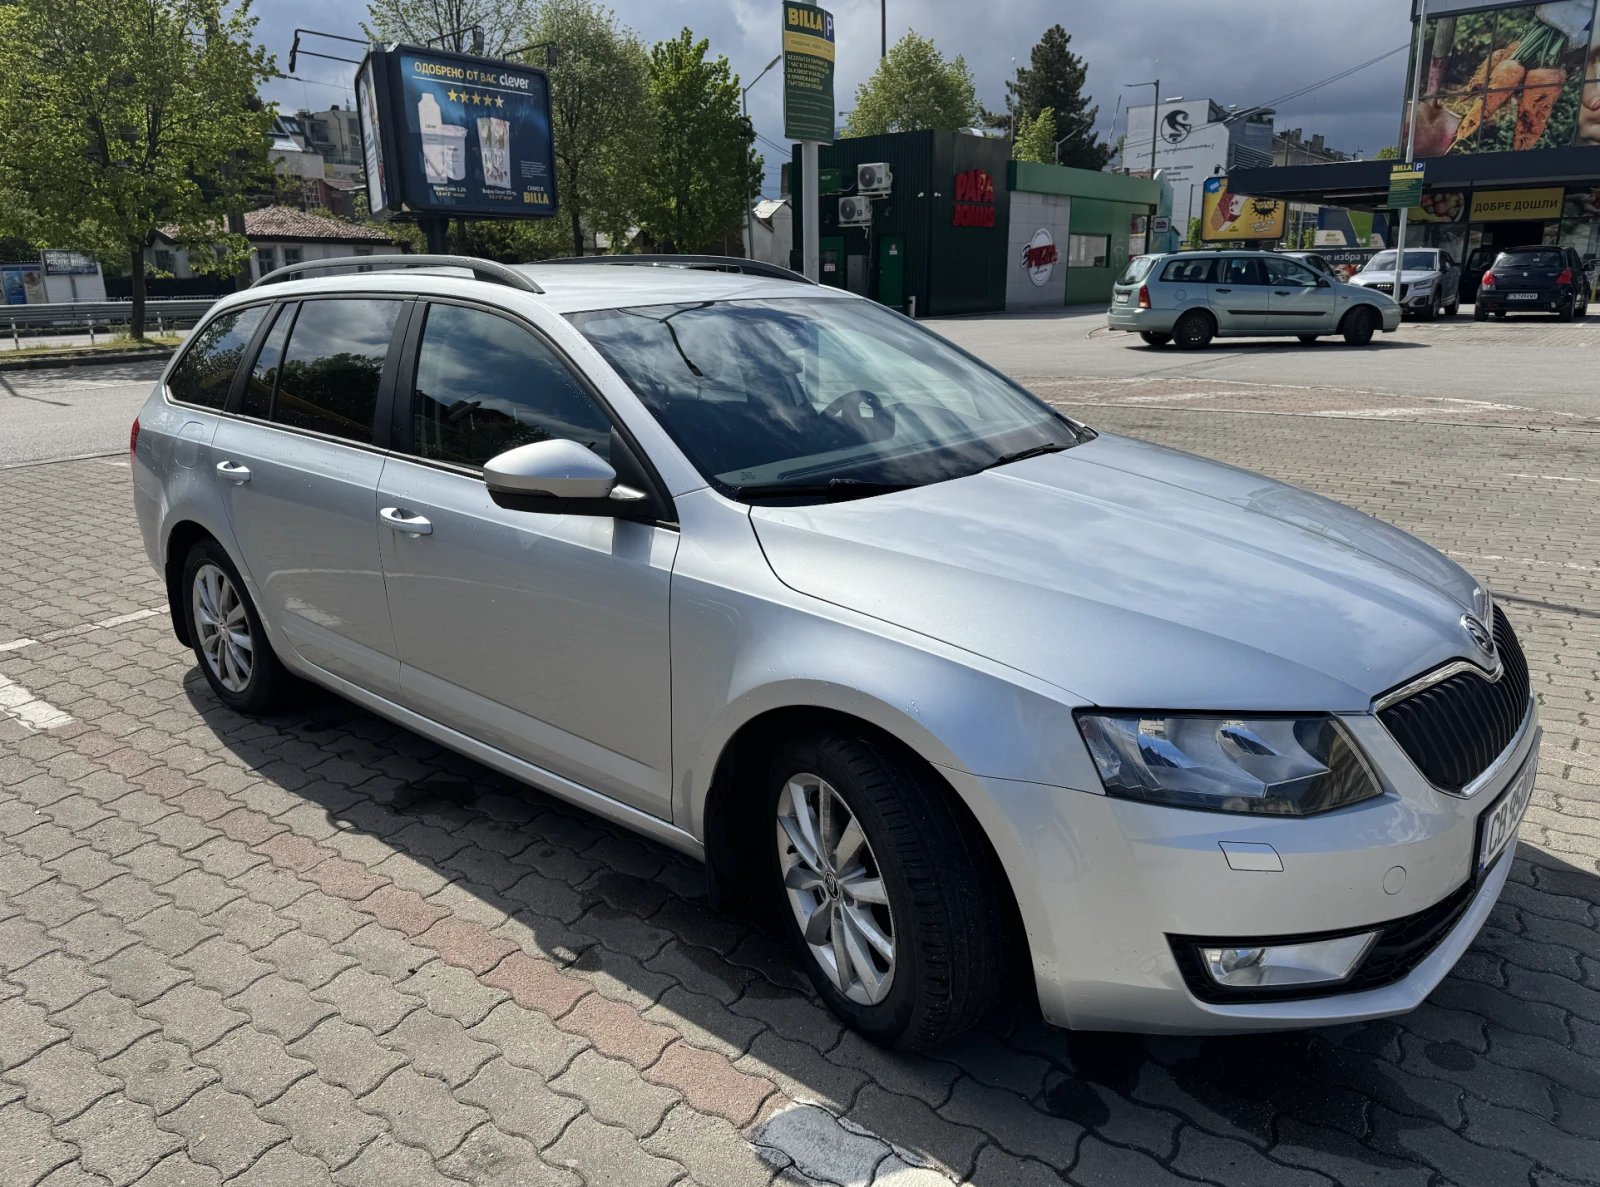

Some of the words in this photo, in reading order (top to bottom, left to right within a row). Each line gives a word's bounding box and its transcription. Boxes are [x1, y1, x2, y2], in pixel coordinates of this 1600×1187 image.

[787, 7, 823, 31] BILLA
[826, 15, 833, 37] P
[414, 62, 464, 79] ОДОБРЕНО
[466, 71, 479, 81] ОТ
[480, 73, 497, 84] ВАС
[499, 73, 529, 90] clever
[1393, 164, 1412, 172] BILLA
[1416, 163, 1423, 171] P
[955, 169, 994, 203] PAPA
[523, 191, 550, 205] BILLA
[1474, 201, 1511, 214] ДОБРЕ
[1513, 199, 1558, 212] ДОШЛИ
[952, 204, 995, 228] JOHNS
[1334, 252, 1361, 262] избра
